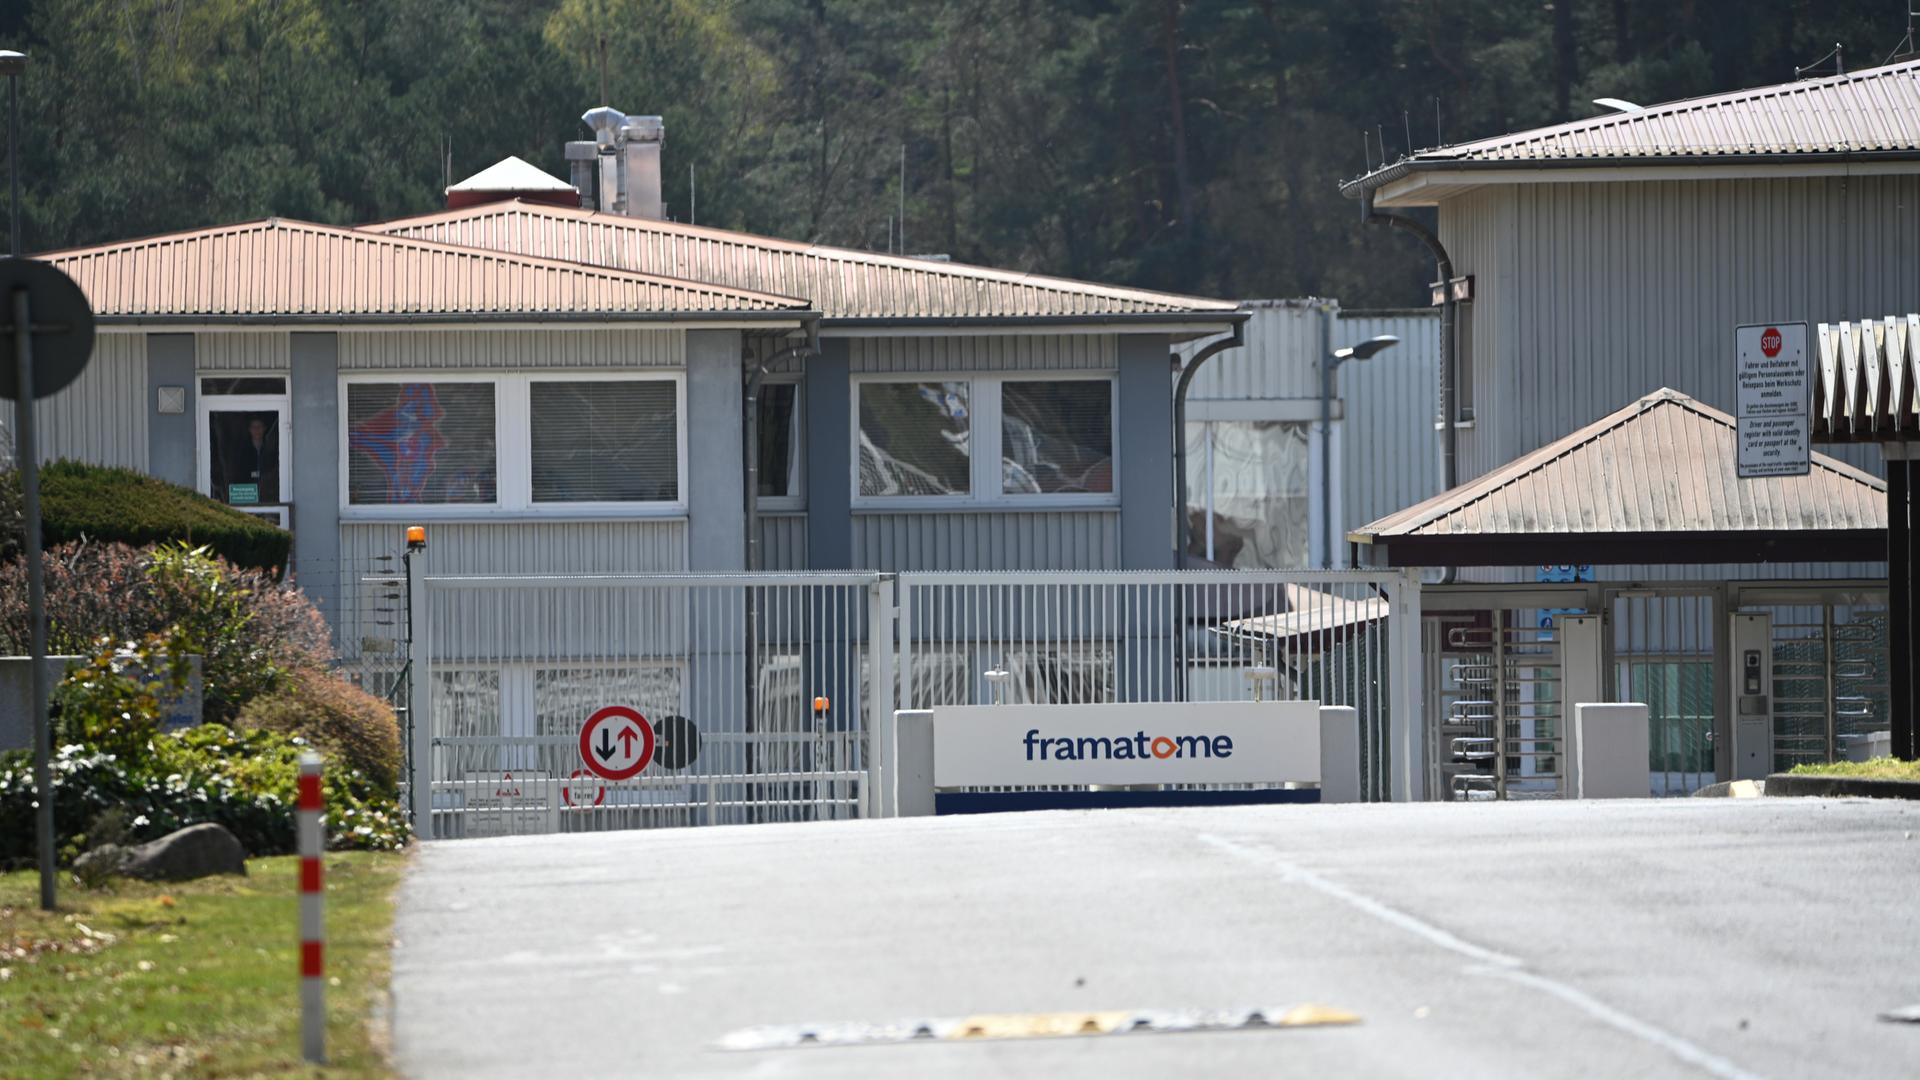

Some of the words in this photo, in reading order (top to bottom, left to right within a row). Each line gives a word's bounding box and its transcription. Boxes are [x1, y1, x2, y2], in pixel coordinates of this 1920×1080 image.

[1762, 336, 1780, 350] STOP
[1763, 420, 1772, 428] and
[1762, 429, 1771, 437] with
[1022, 729, 1233, 760] framatome
